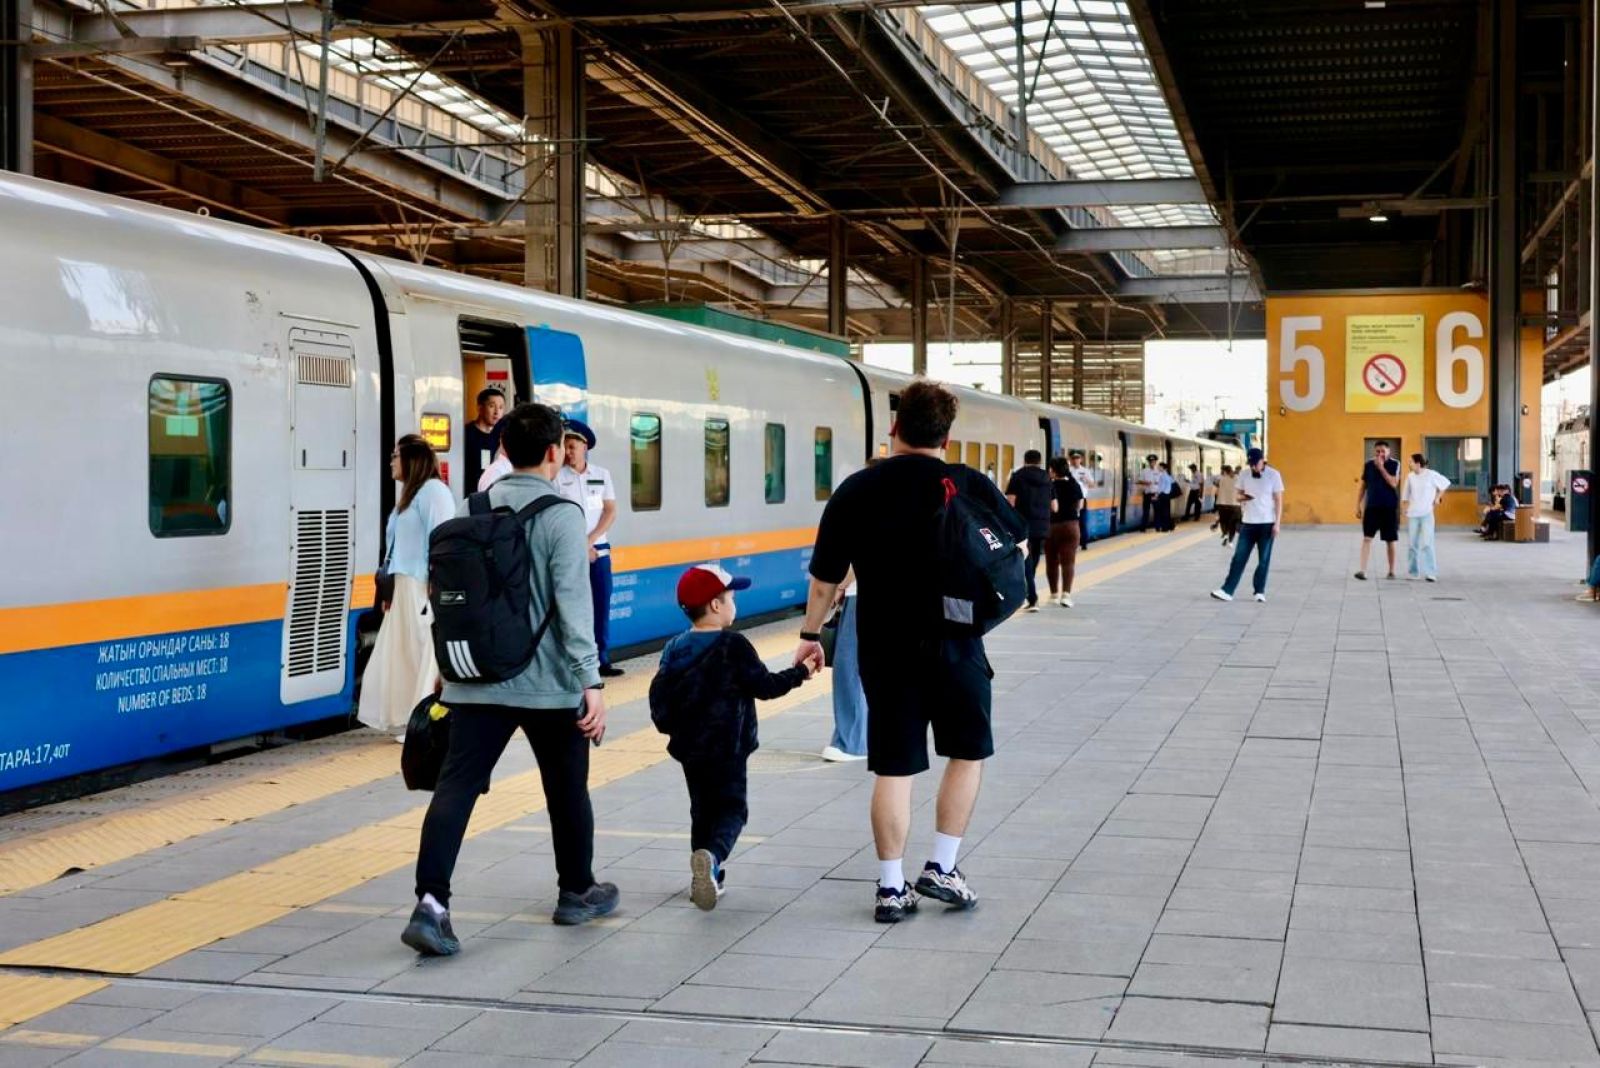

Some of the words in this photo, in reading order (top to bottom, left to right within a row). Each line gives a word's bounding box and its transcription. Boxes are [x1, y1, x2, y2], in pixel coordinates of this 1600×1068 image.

[1279, 316, 1326, 412] 5
[1436, 311, 1484, 408] 6
[97, 643, 136, 664] ЖАТЫН
[138, 636, 187, 659] ОРЫНДАР
[188, 634, 217, 653] САНЫ:
[219, 632, 230, 649] 18
[95, 667, 151, 691] КОЛИЧЕСТВО
[152, 661, 195, 683] СПАЛЬНЫХ
[196, 657, 218, 676] МЕСТ:
[219, 656, 228, 673] 18
[117, 692, 157, 714] NUMBER
[158, 689, 171, 707] OF
[171, 685, 195, 705] BEDS:
[197, 683, 207, 700] 18
